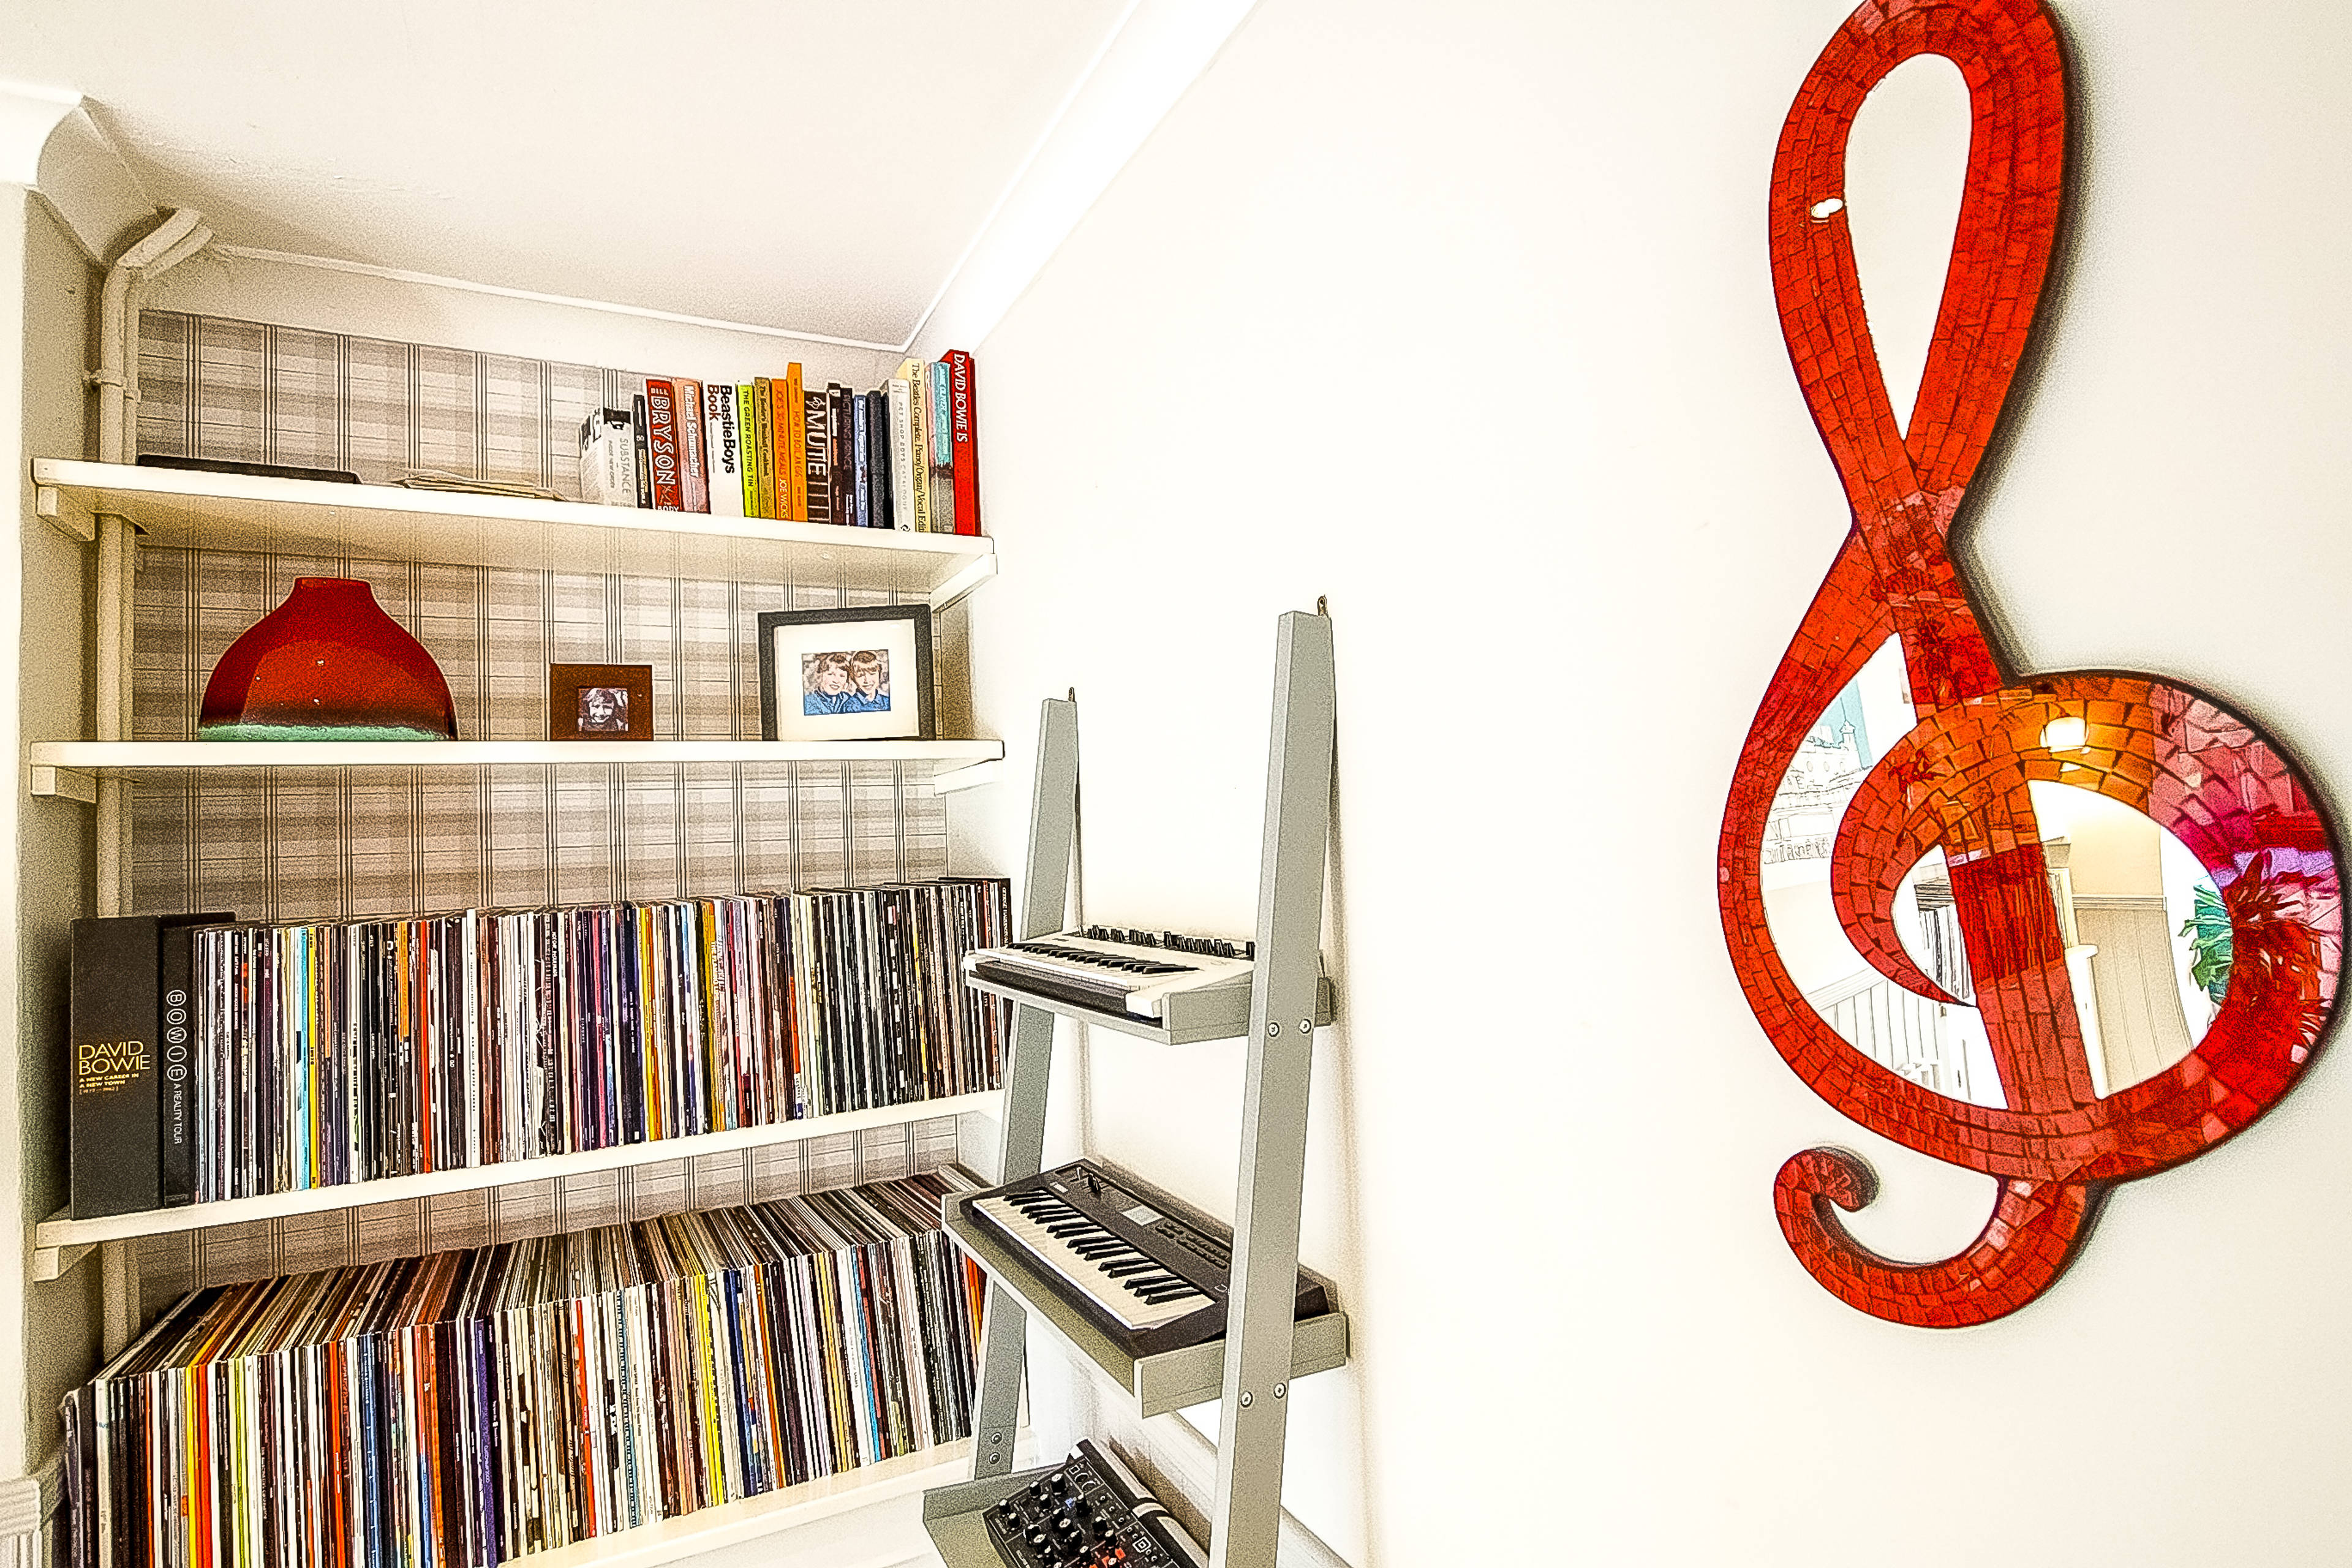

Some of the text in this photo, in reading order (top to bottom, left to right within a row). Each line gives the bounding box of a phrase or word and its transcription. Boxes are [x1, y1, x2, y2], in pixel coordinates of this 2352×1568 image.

[684, 385, 696, 421] Michael
[707, 384, 721, 421] Book
[954, 353, 968, 442] DAVID BOWIE IS
[651, 396, 676, 484] BRYSON
[687, 421, 701, 478] Schumacher
[745, 434, 753, 472] ROASTING
[805, 410, 826, 476] MUTE
[842, 394, 852, 471] PICTURING PRINCE
[619, 437, 631, 494] SUBSTANCE
[79, 1041, 144, 1060] DAVID
[167, 990, 187, 1081] BOWIE
[79, 1055, 151, 1076] BOWIE
